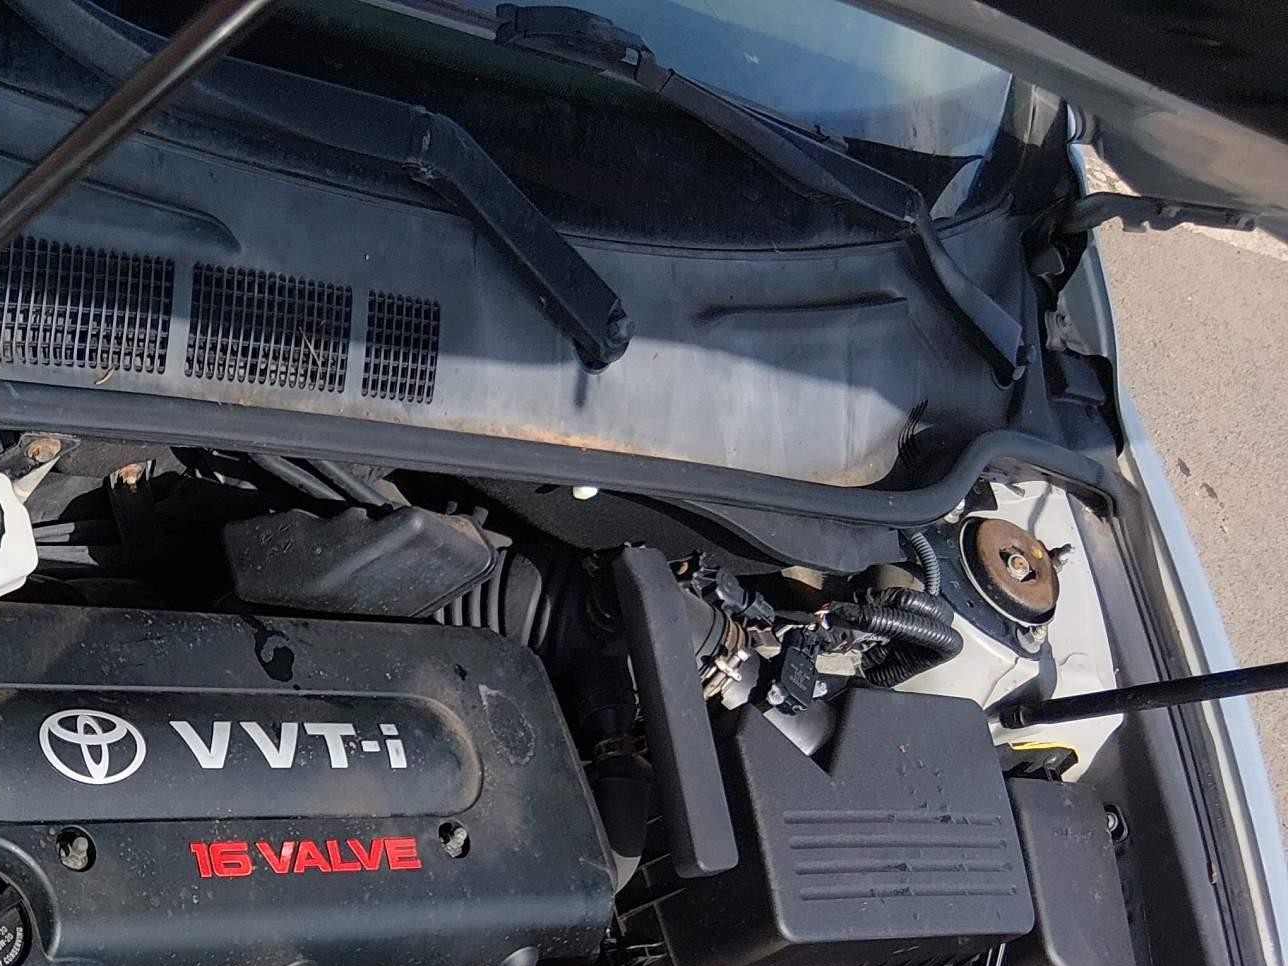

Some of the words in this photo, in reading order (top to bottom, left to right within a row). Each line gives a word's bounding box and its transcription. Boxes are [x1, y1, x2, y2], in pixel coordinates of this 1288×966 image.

[169, 721, 408, 769] VVT-i
[190, 841, 253, 878] 16
[256, 837, 422, 874] VALVE
[3, 926, 24, 965] CONSERVING
